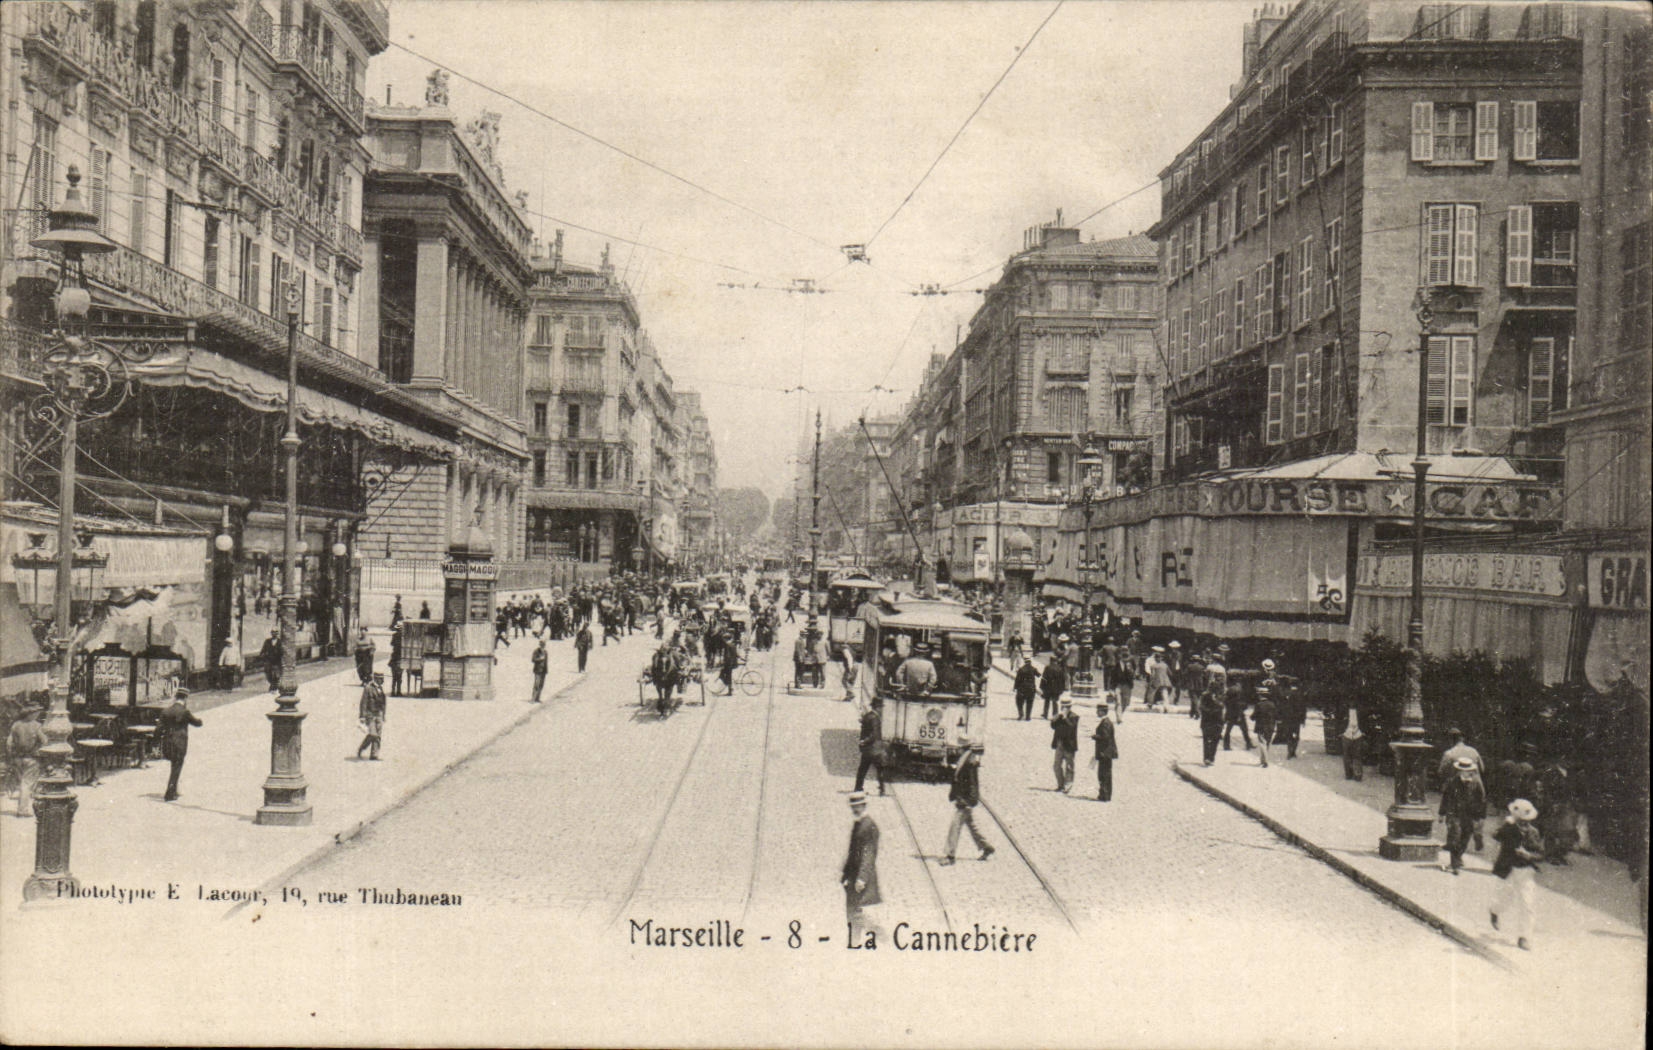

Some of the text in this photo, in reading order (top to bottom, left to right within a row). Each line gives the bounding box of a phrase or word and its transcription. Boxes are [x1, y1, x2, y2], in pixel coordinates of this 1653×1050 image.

[470, 564, 496, 574] MAGGI
[1490, 557, 1546, 592] BAR
[920, 725, 945, 739] 652
